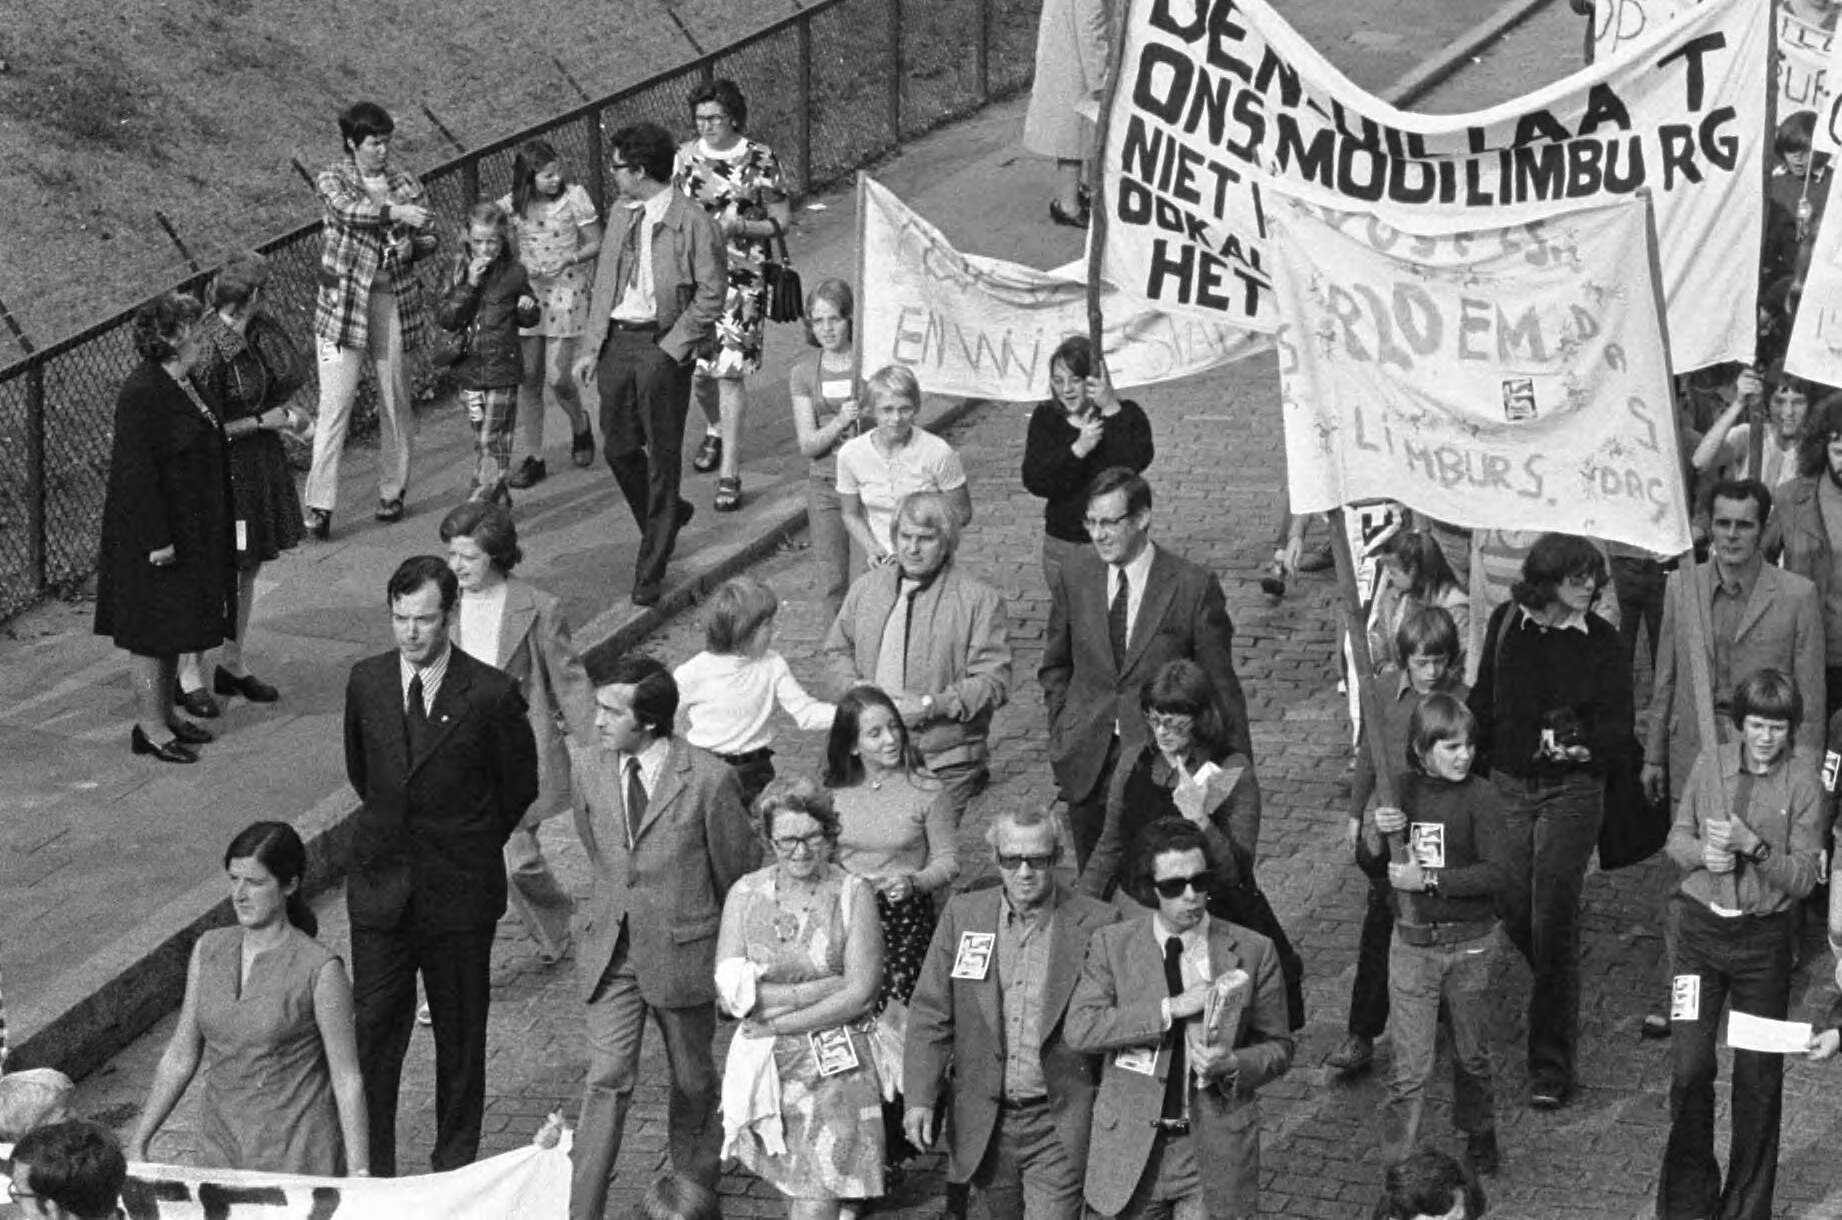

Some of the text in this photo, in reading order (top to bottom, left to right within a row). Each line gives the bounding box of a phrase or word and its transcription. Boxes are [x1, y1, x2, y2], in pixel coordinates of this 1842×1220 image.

[1133, 41, 1740, 208] ONS MOOI LIMBURG
[1467, 30, 1727, 156] LAAT
[1117, 176, 1213, 248] OOK
[1119, 116, 1241, 220] NIET
[1145, 237, 1272, 317] HET
[892, 303, 945, 370] EN
